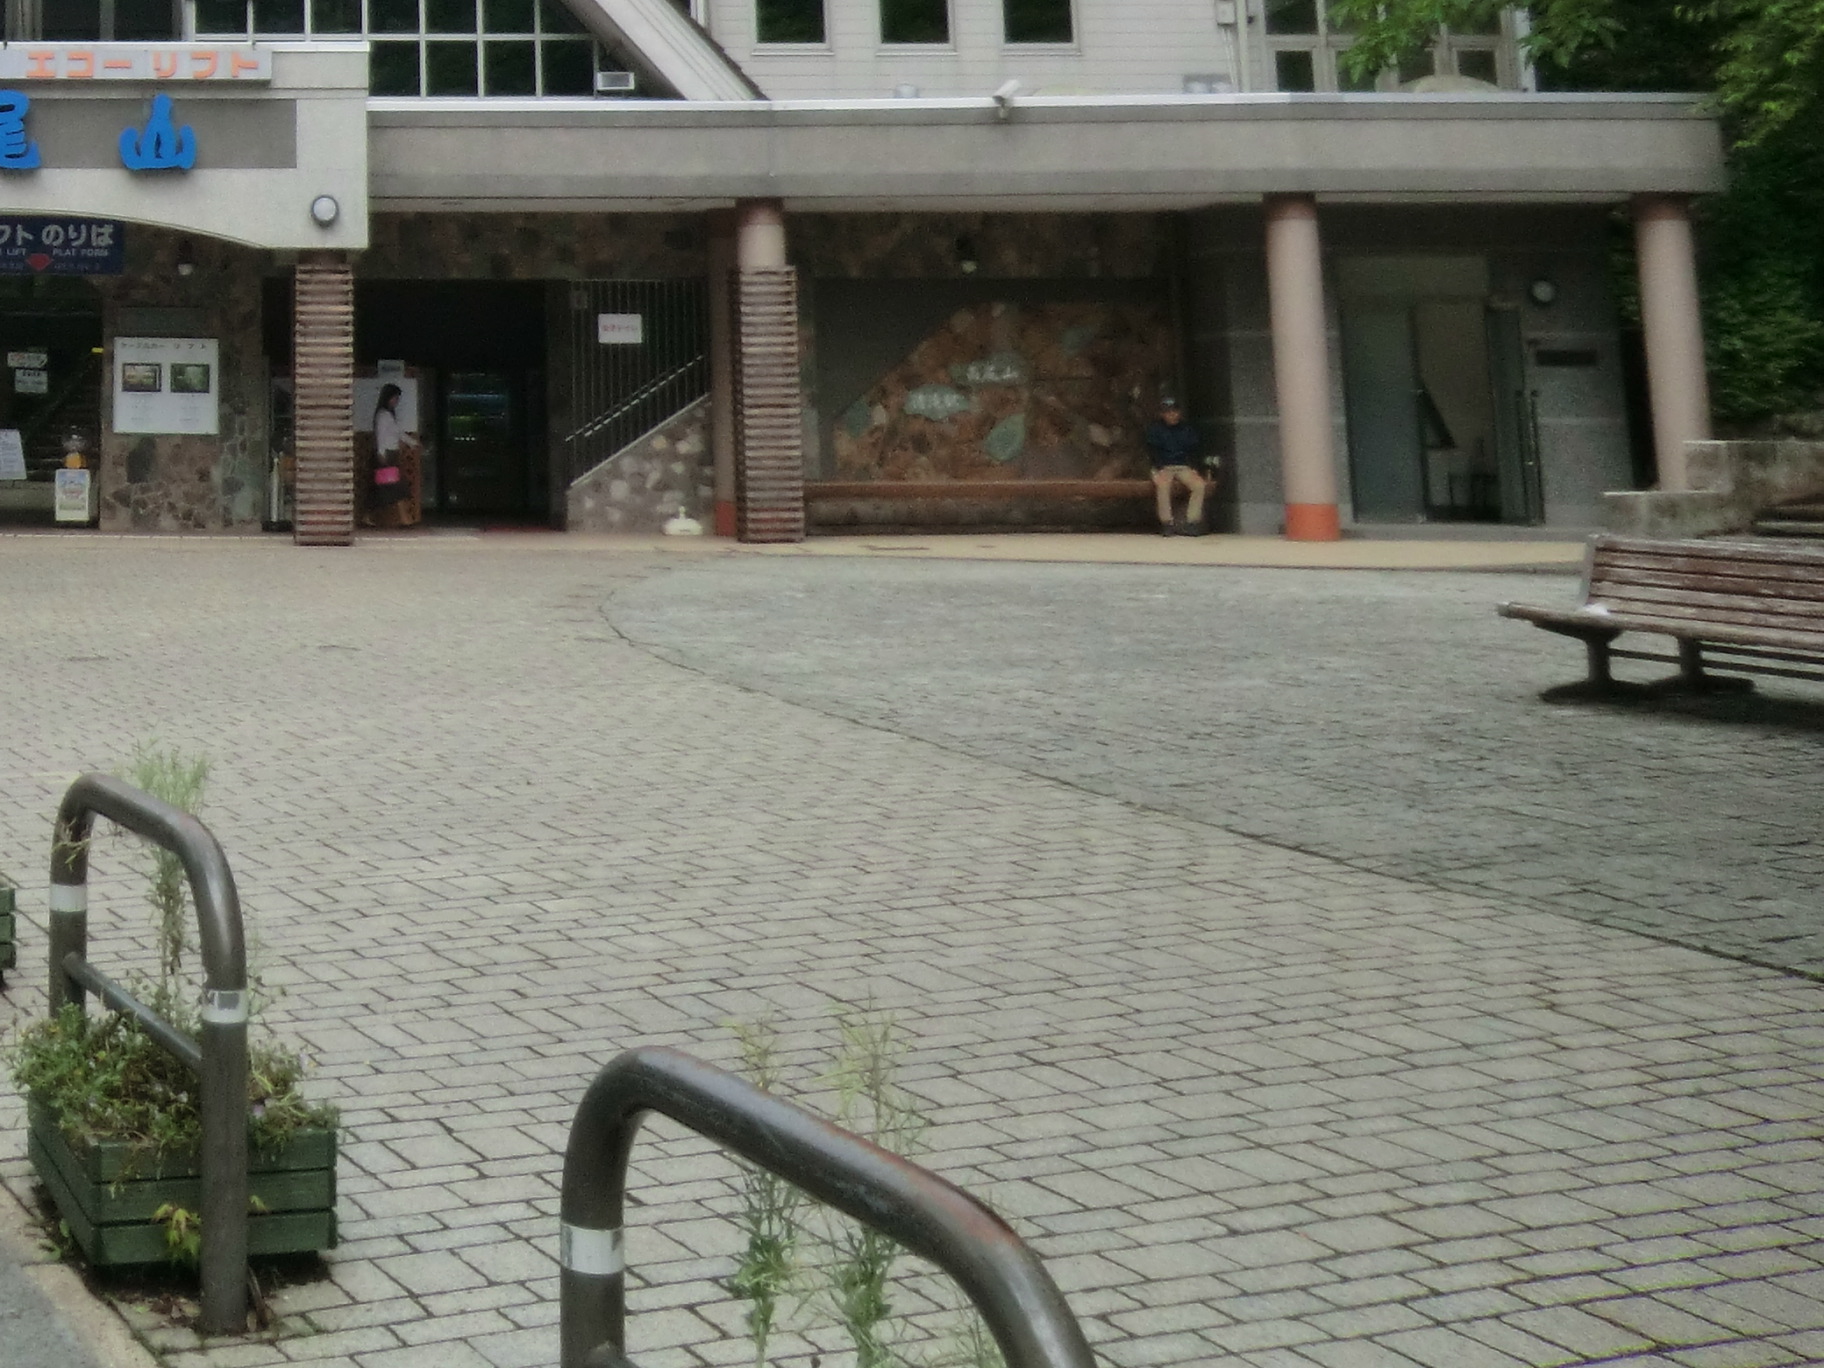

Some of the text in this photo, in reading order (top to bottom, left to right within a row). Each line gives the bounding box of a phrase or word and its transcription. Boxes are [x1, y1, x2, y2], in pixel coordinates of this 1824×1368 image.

[41, 223, 114, 246] のりば
[6, 247, 27, 257] LIFT
[52, 247, 76, 257] PLAT
